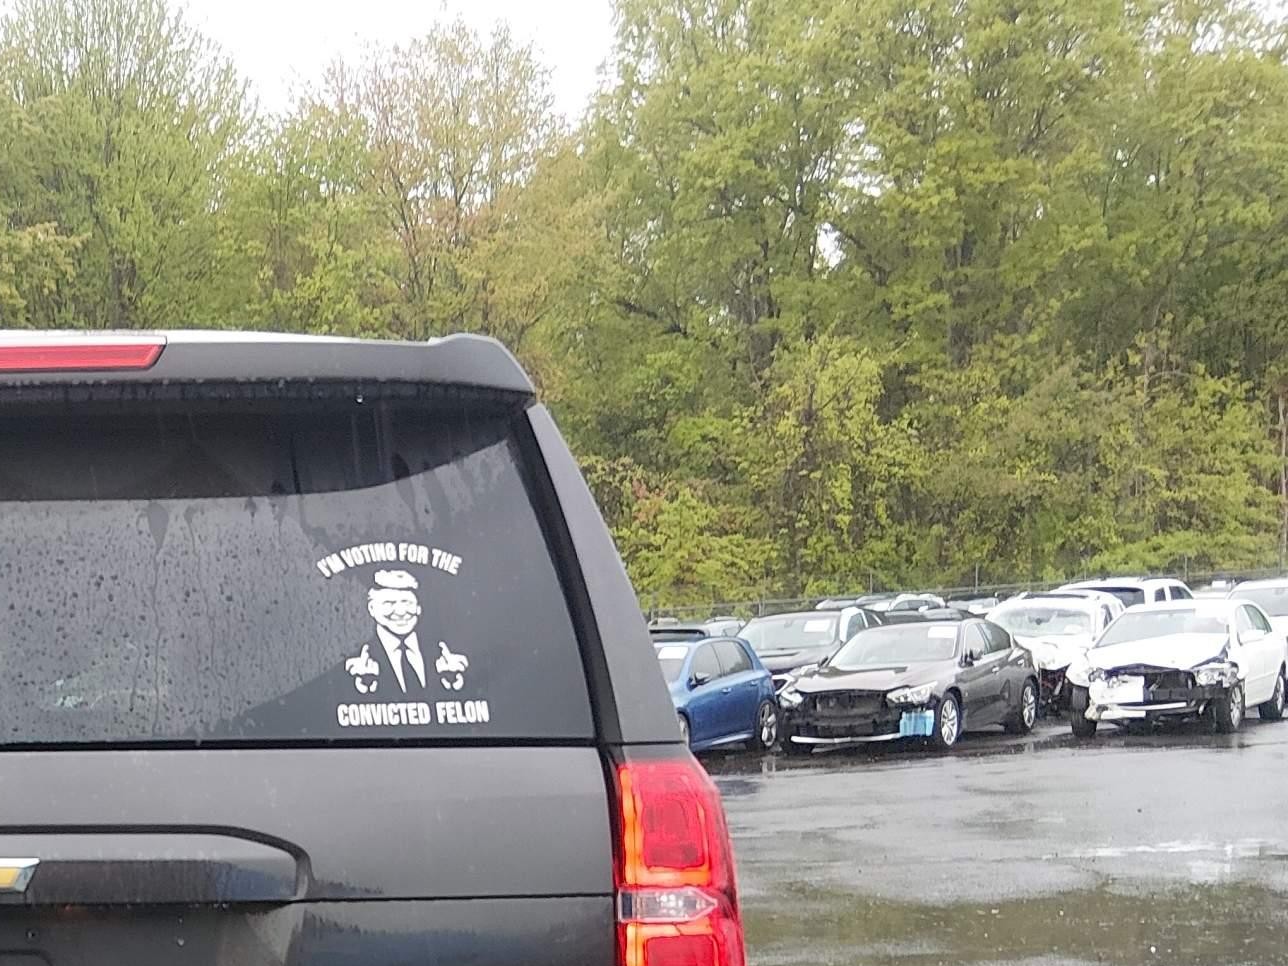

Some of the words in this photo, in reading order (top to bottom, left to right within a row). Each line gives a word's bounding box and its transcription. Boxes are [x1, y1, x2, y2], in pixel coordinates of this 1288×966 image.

[317, 553, 345, 578] I'M
[340, 542, 397, 567] VOTING
[398, 542, 429, 565] FOR
[431, 548, 463, 575] THE
[337, 702, 431, 726] CONVICTED
[435, 700, 490, 723] FELON
